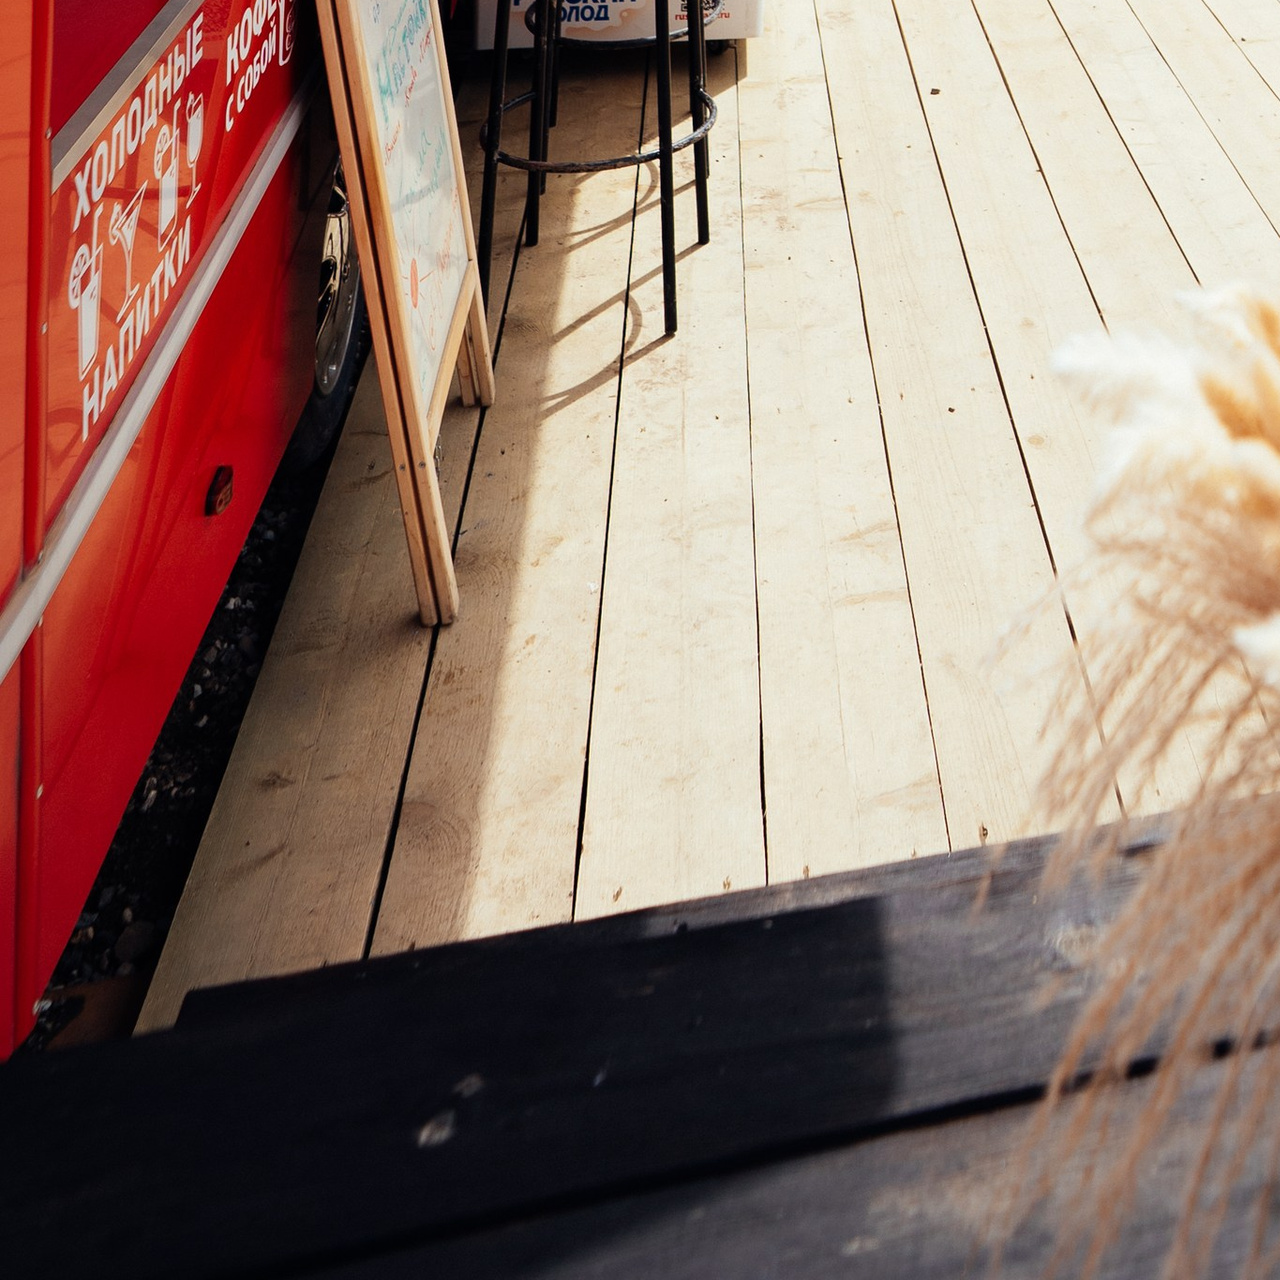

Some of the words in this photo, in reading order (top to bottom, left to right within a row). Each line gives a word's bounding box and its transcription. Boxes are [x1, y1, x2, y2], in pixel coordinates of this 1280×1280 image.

[71, 11, 205, 233] ХОЛОДНЫЕ
[223, 95, 235, 133] С
[236, 27, 279, 117] СОБОЙ
[82, 214, 192, 444] НАПИТКИ
